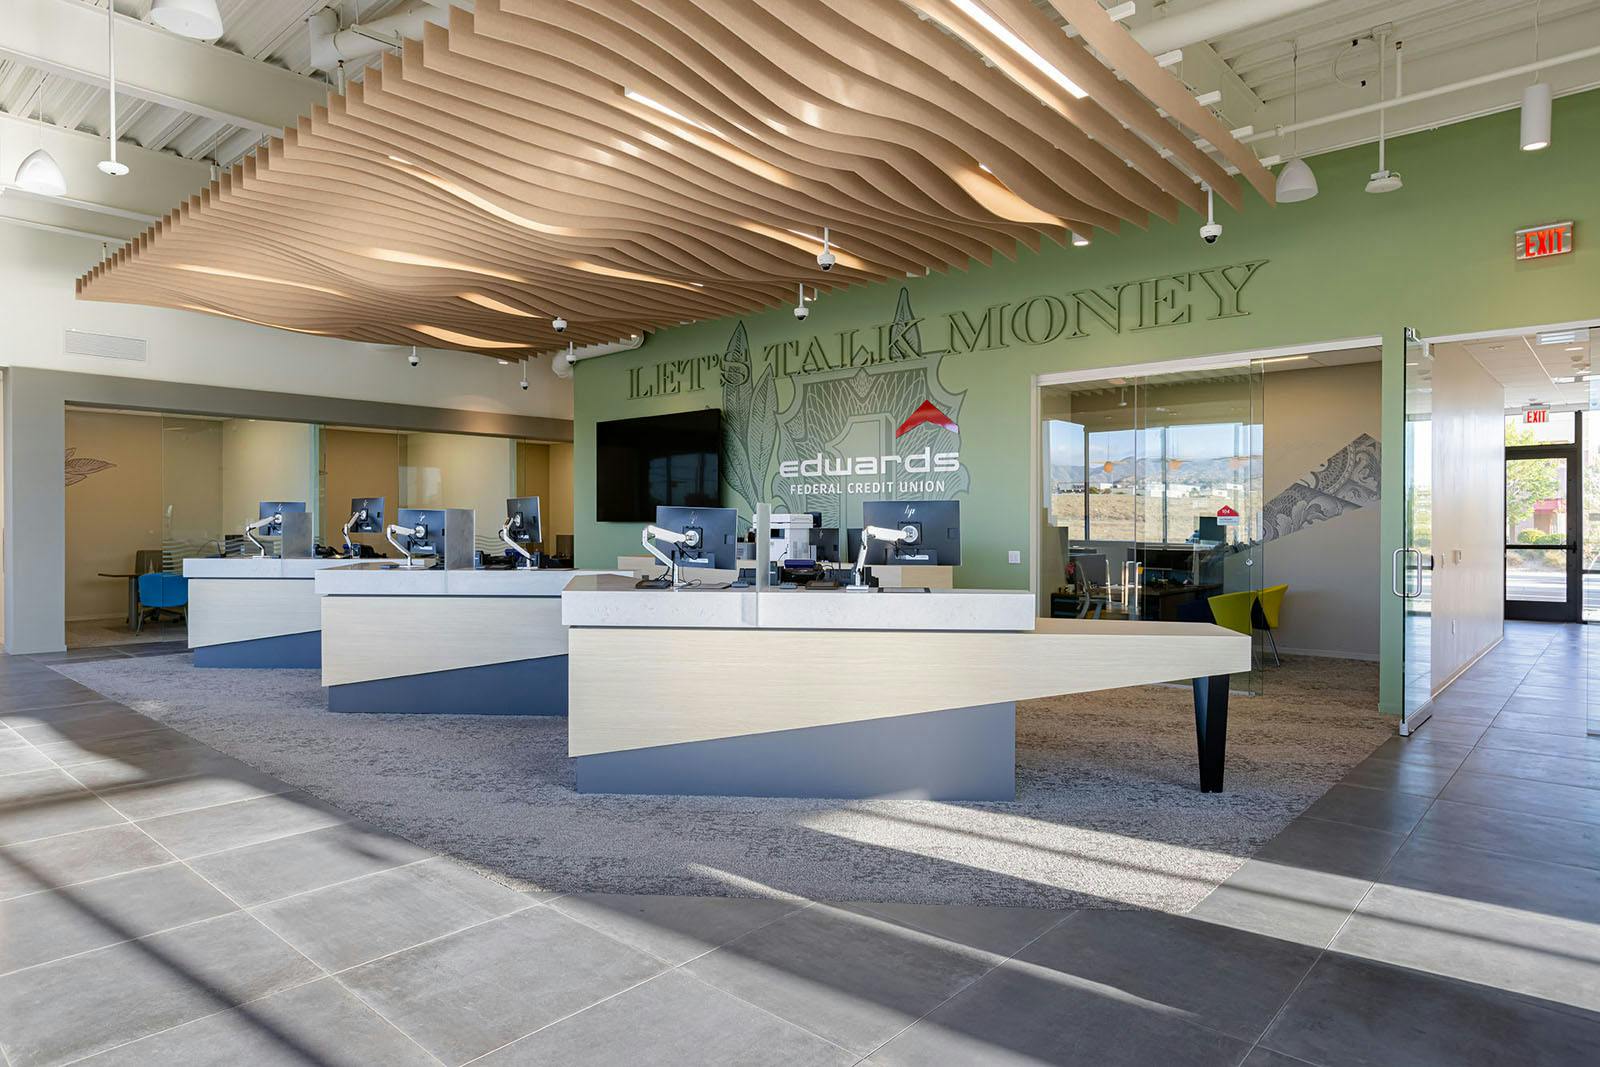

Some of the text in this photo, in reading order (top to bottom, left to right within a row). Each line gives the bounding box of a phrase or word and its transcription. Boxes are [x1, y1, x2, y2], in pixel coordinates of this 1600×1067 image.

[1525, 227, 1566, 257] EXIT
[625, 259, 1270, 400] LET'S TALK MONEY
[1527, 409, 1547, 424] EXIT
[779, 446, 960, 478] edwards
[789, 479, 945, 495] FEDERAL CREDIT UNION
[904, 504, 916, 519] hp
